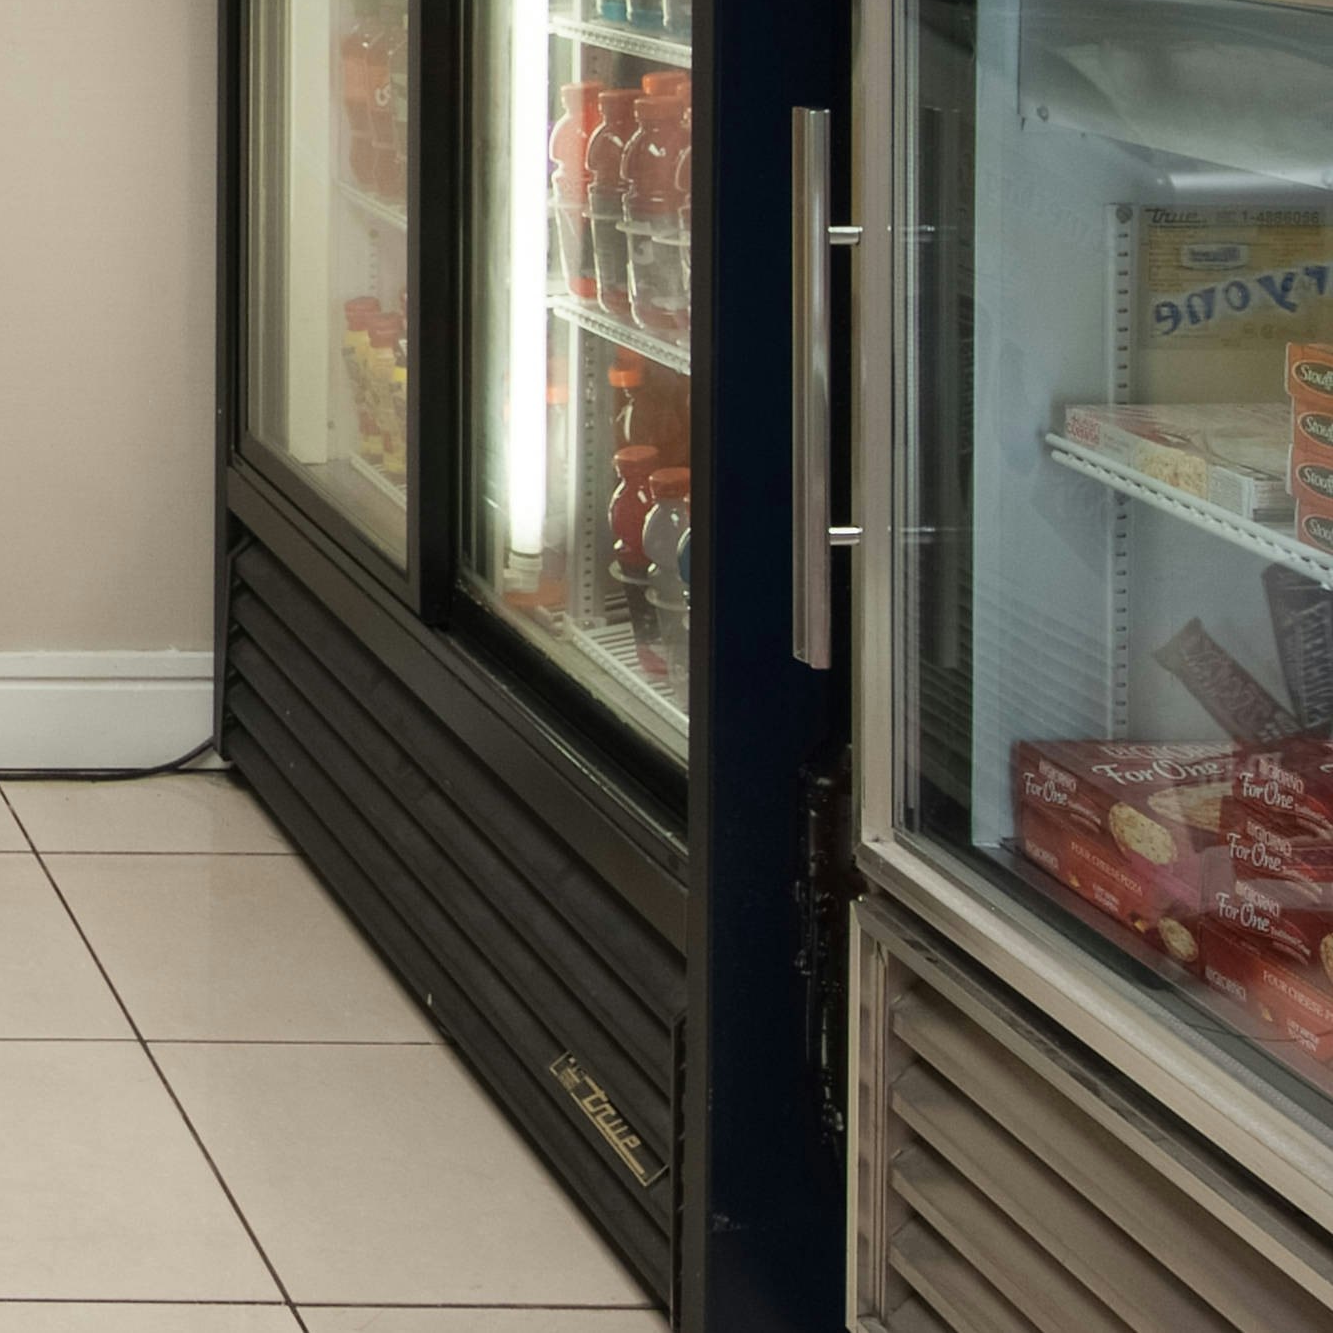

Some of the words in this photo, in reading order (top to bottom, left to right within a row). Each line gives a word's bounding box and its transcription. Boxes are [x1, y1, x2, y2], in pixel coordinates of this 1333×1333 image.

[1023, 772, 1044, 796] For
[1043, 780, 1068, 806] One
[1091, 763, 1156, 786] For
[1152, 758, 1225, 780] One
[1240, 772, 1265, 798] For
[1264, 781, 1294, 810] One
[1227, 832, 1251, 860] For
[1251, 842, 1282, 871] One
[1216, 891, 1240, 919] For
[1240, 901, 1271, 933] One
